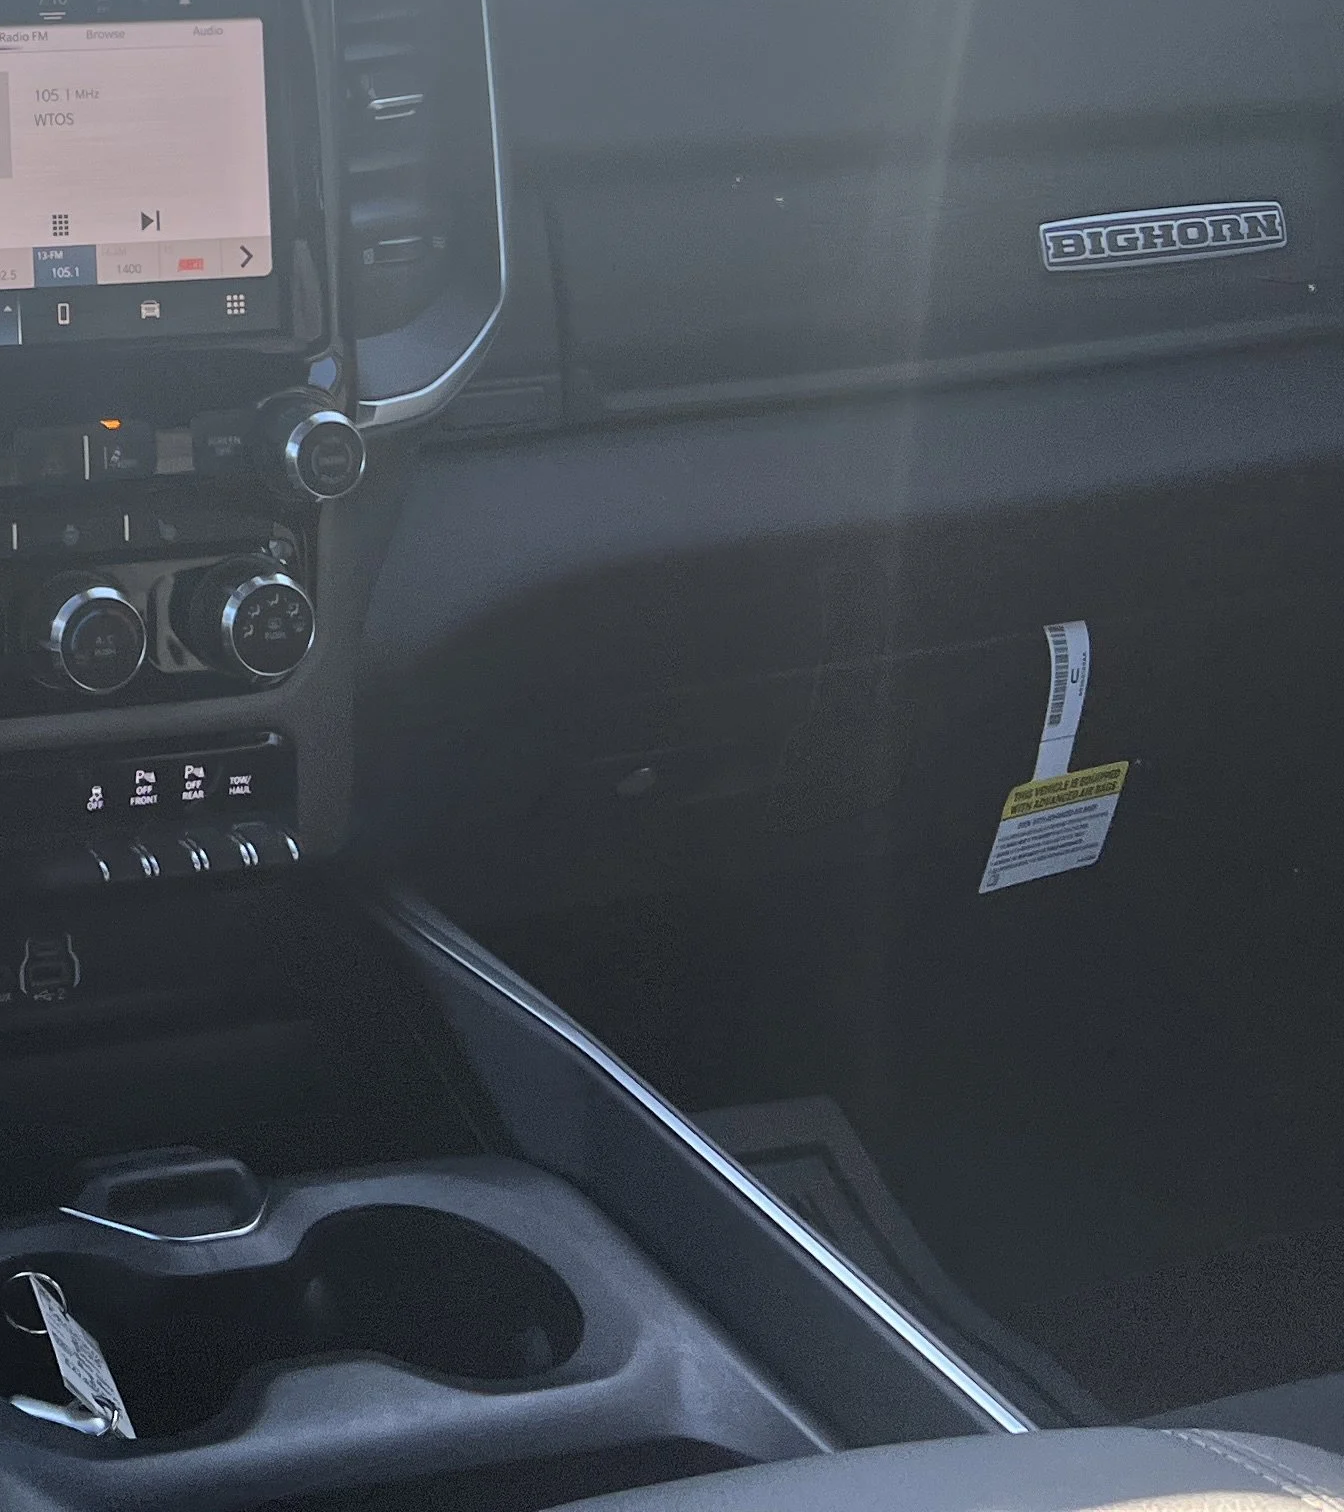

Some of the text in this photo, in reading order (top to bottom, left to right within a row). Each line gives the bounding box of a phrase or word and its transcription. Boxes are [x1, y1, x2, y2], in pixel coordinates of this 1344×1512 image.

[0, 31, 29, 43] Radio
[31, 31, 49, 42] FM
[85, 28, 126, 40] Browse
[192, 25, 224, 37] Audio
[74, 88, 100, 100] MHz
[34, 112, 75, 127] WTOS
[1045, 210, 1283, 263] BIGHORN
[37, 250, 65, 261] 13-FM
[51, 266, 81, 278] 105.1
[117, 264, 143, 274] 1400
[185, 779, 202, 790] OFF
[228, 785, 252, 795] HAUL
[136, 786, 153, 795] OFF
[182, 790, 205, 800] REAR
[86, 800, 104, 811] OFF
[130, 794, 158, 806] FRONT
